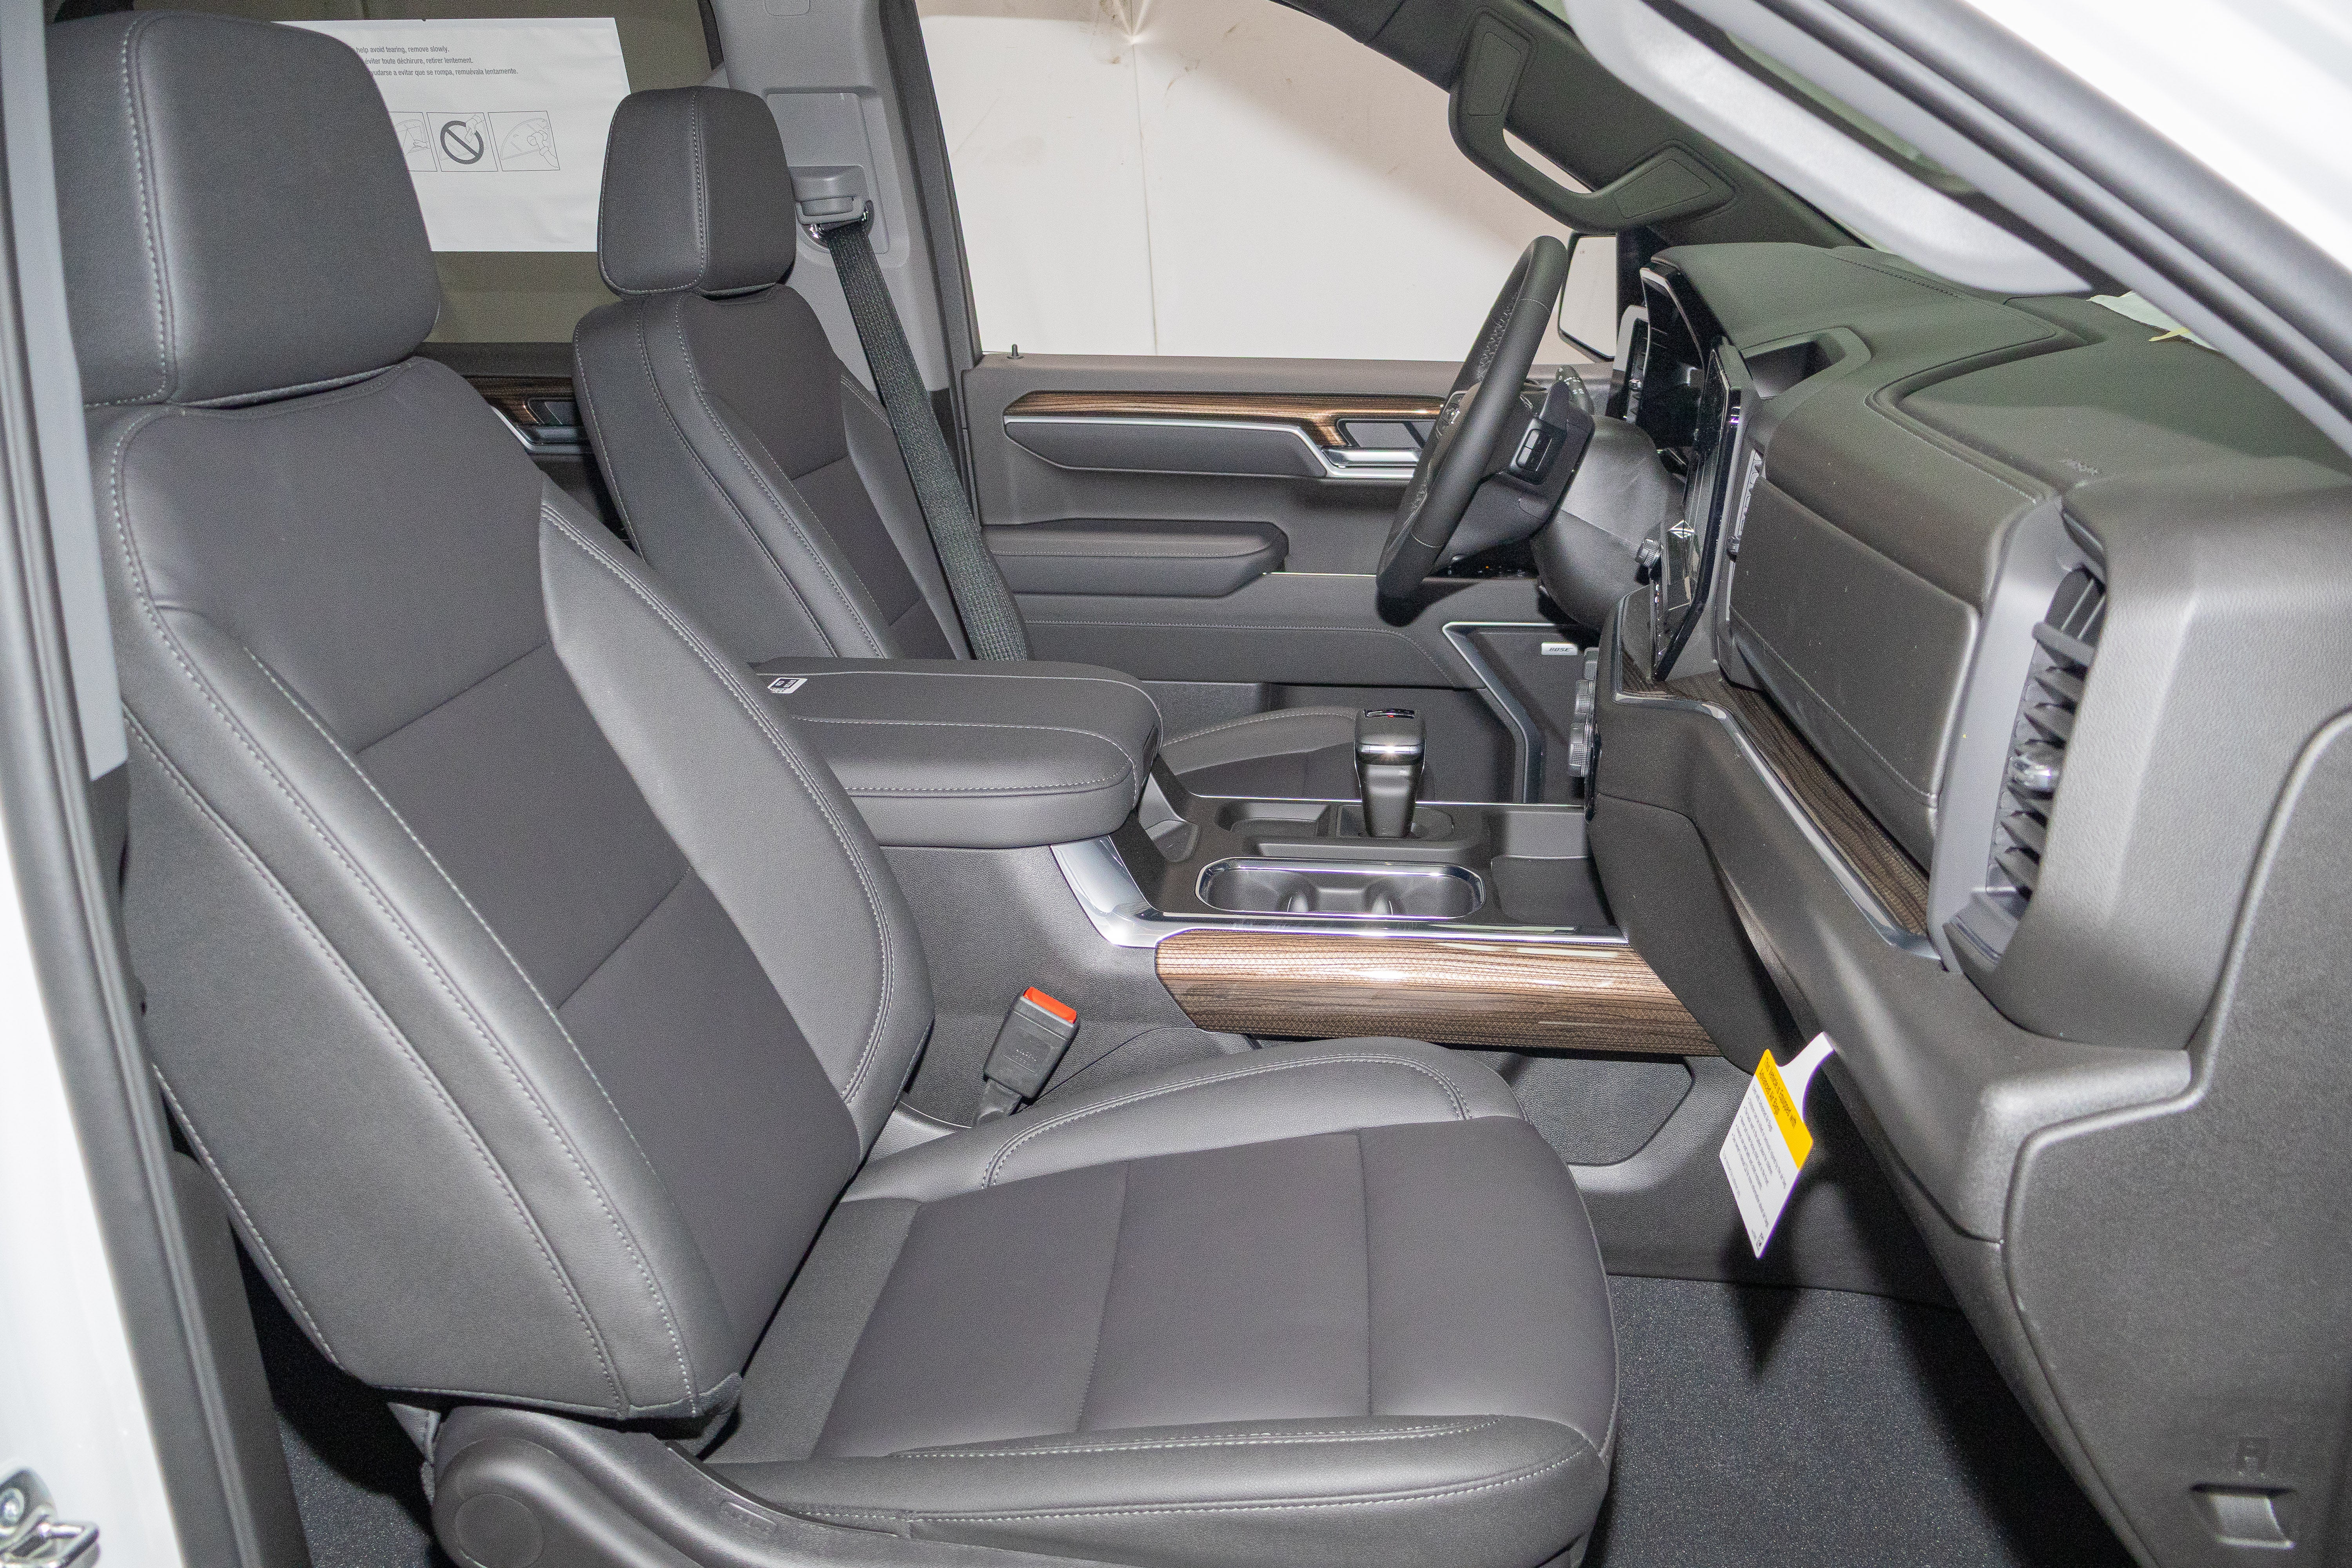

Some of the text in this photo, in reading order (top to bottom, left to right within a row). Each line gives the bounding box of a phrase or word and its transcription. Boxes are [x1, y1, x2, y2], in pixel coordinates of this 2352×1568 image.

[1769, 1067, 1778, 1088] Vehicle
[1777, 1084, 1780, 1093] is
[1759, 1068, 1771, 1094] Advanced
[1771, 1098, 1780, 1116] Bags
[1778, 1089, 1791, 1118] Equipped
